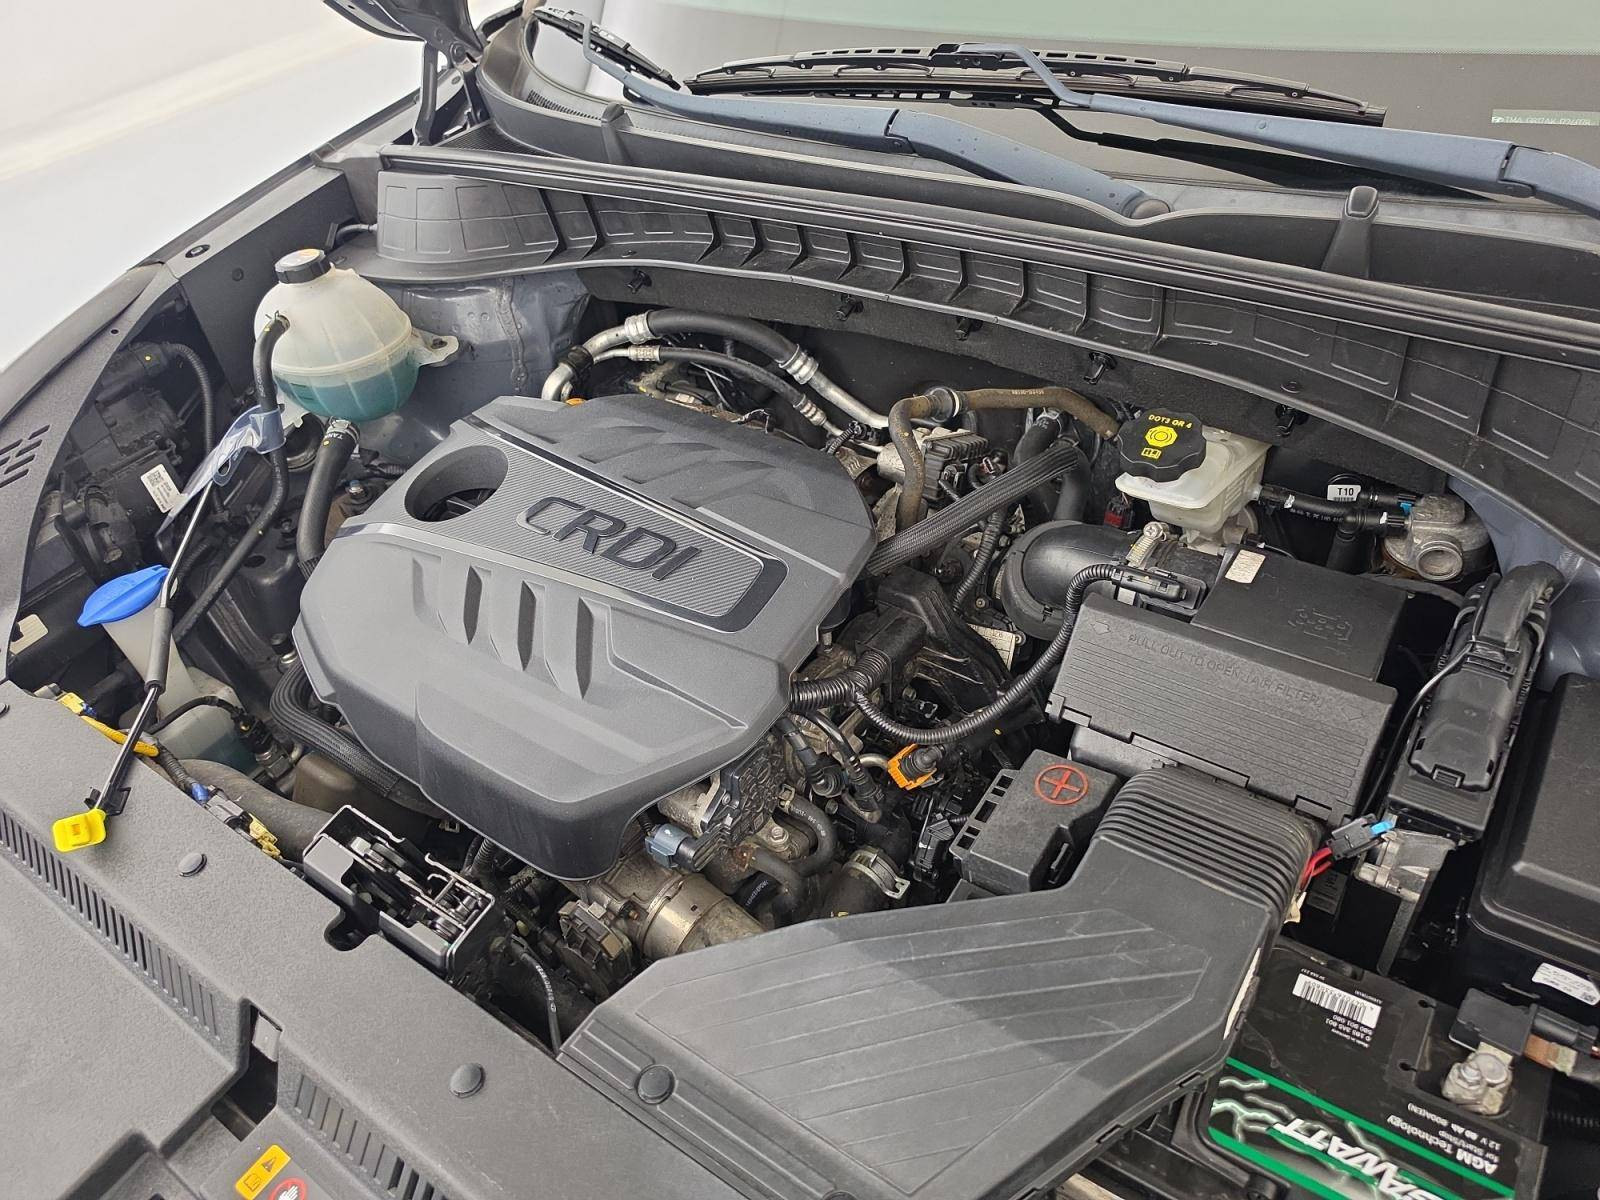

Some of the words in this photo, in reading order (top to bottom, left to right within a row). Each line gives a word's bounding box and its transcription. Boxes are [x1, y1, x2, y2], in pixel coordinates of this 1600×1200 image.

[1148, 414, 1171, 424] DOT3
[1171, 419, 1186, 427] OR
[1337, 487, 1354, 496] T10
[516, 496, 702, 581] CRDI
[1128, 634, 1155, 651] PULL
[1161, 645, 1186, 660] OUT
[1190, 653, 1204, 668] TO
[1207, 659, 1240, 680] OPEN
[1387, 1114, 1454, 1155] Technology
[1438, 1129, 1485, 1159] Start/Stop
[1488, 1140, 1502, 1151] 12
[1455, 1151, 1499, 1175] AGM
